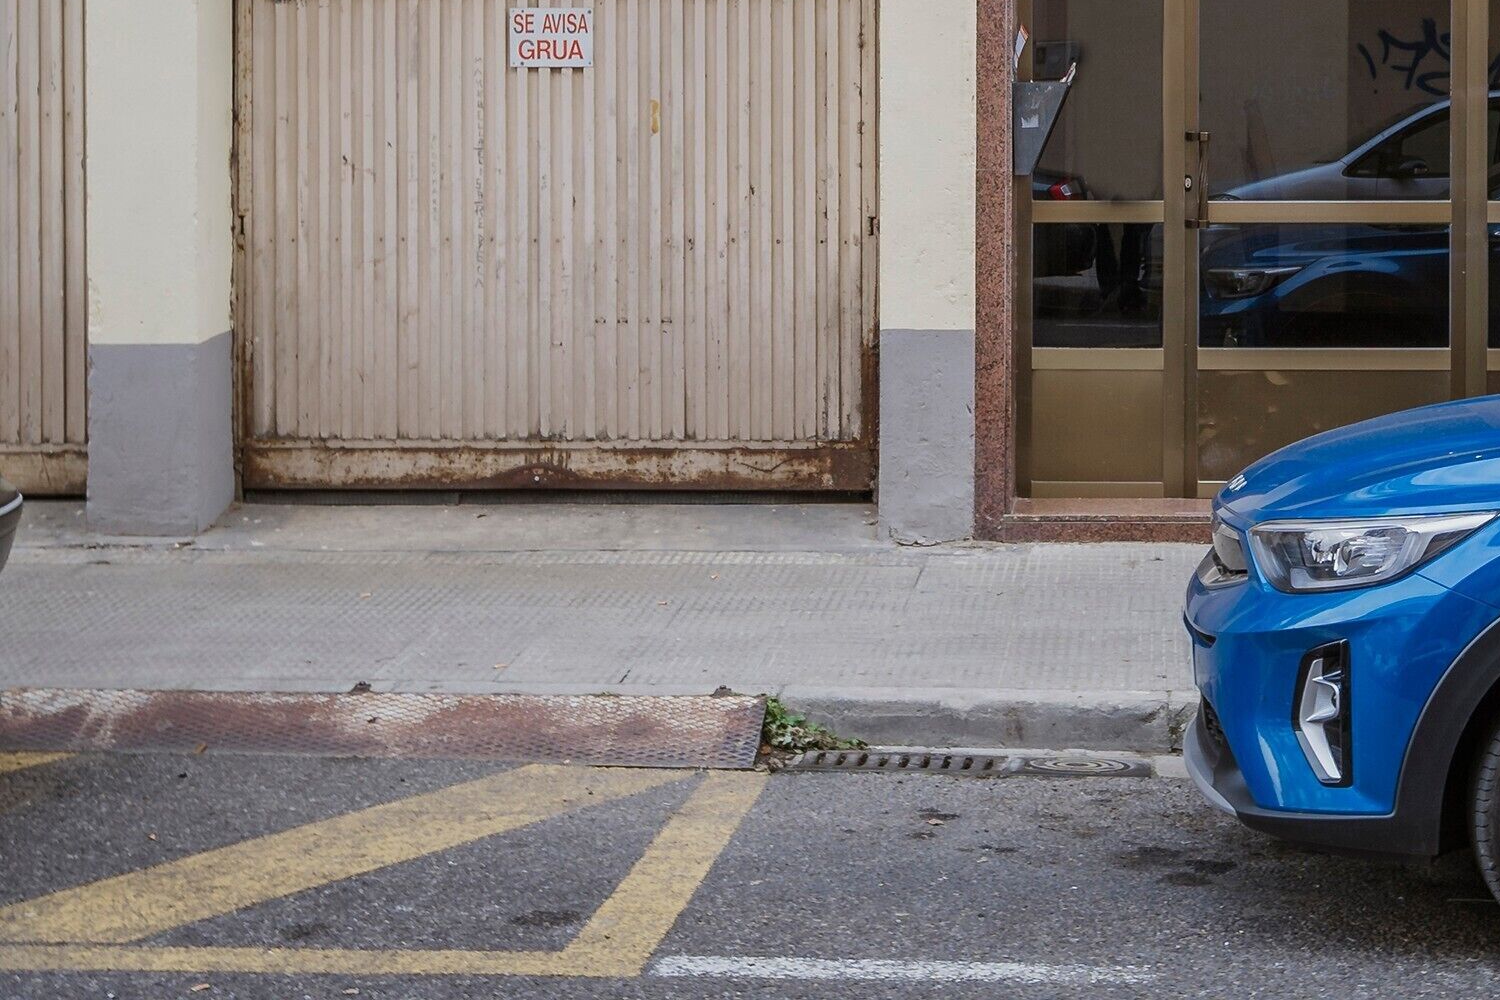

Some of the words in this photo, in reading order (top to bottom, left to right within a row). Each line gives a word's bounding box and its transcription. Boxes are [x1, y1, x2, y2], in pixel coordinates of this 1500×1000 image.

[513, 13, 535, 34] SE
[542, 13, 589, 34] AVISA
[518, 39, 584, 60] GRUA
